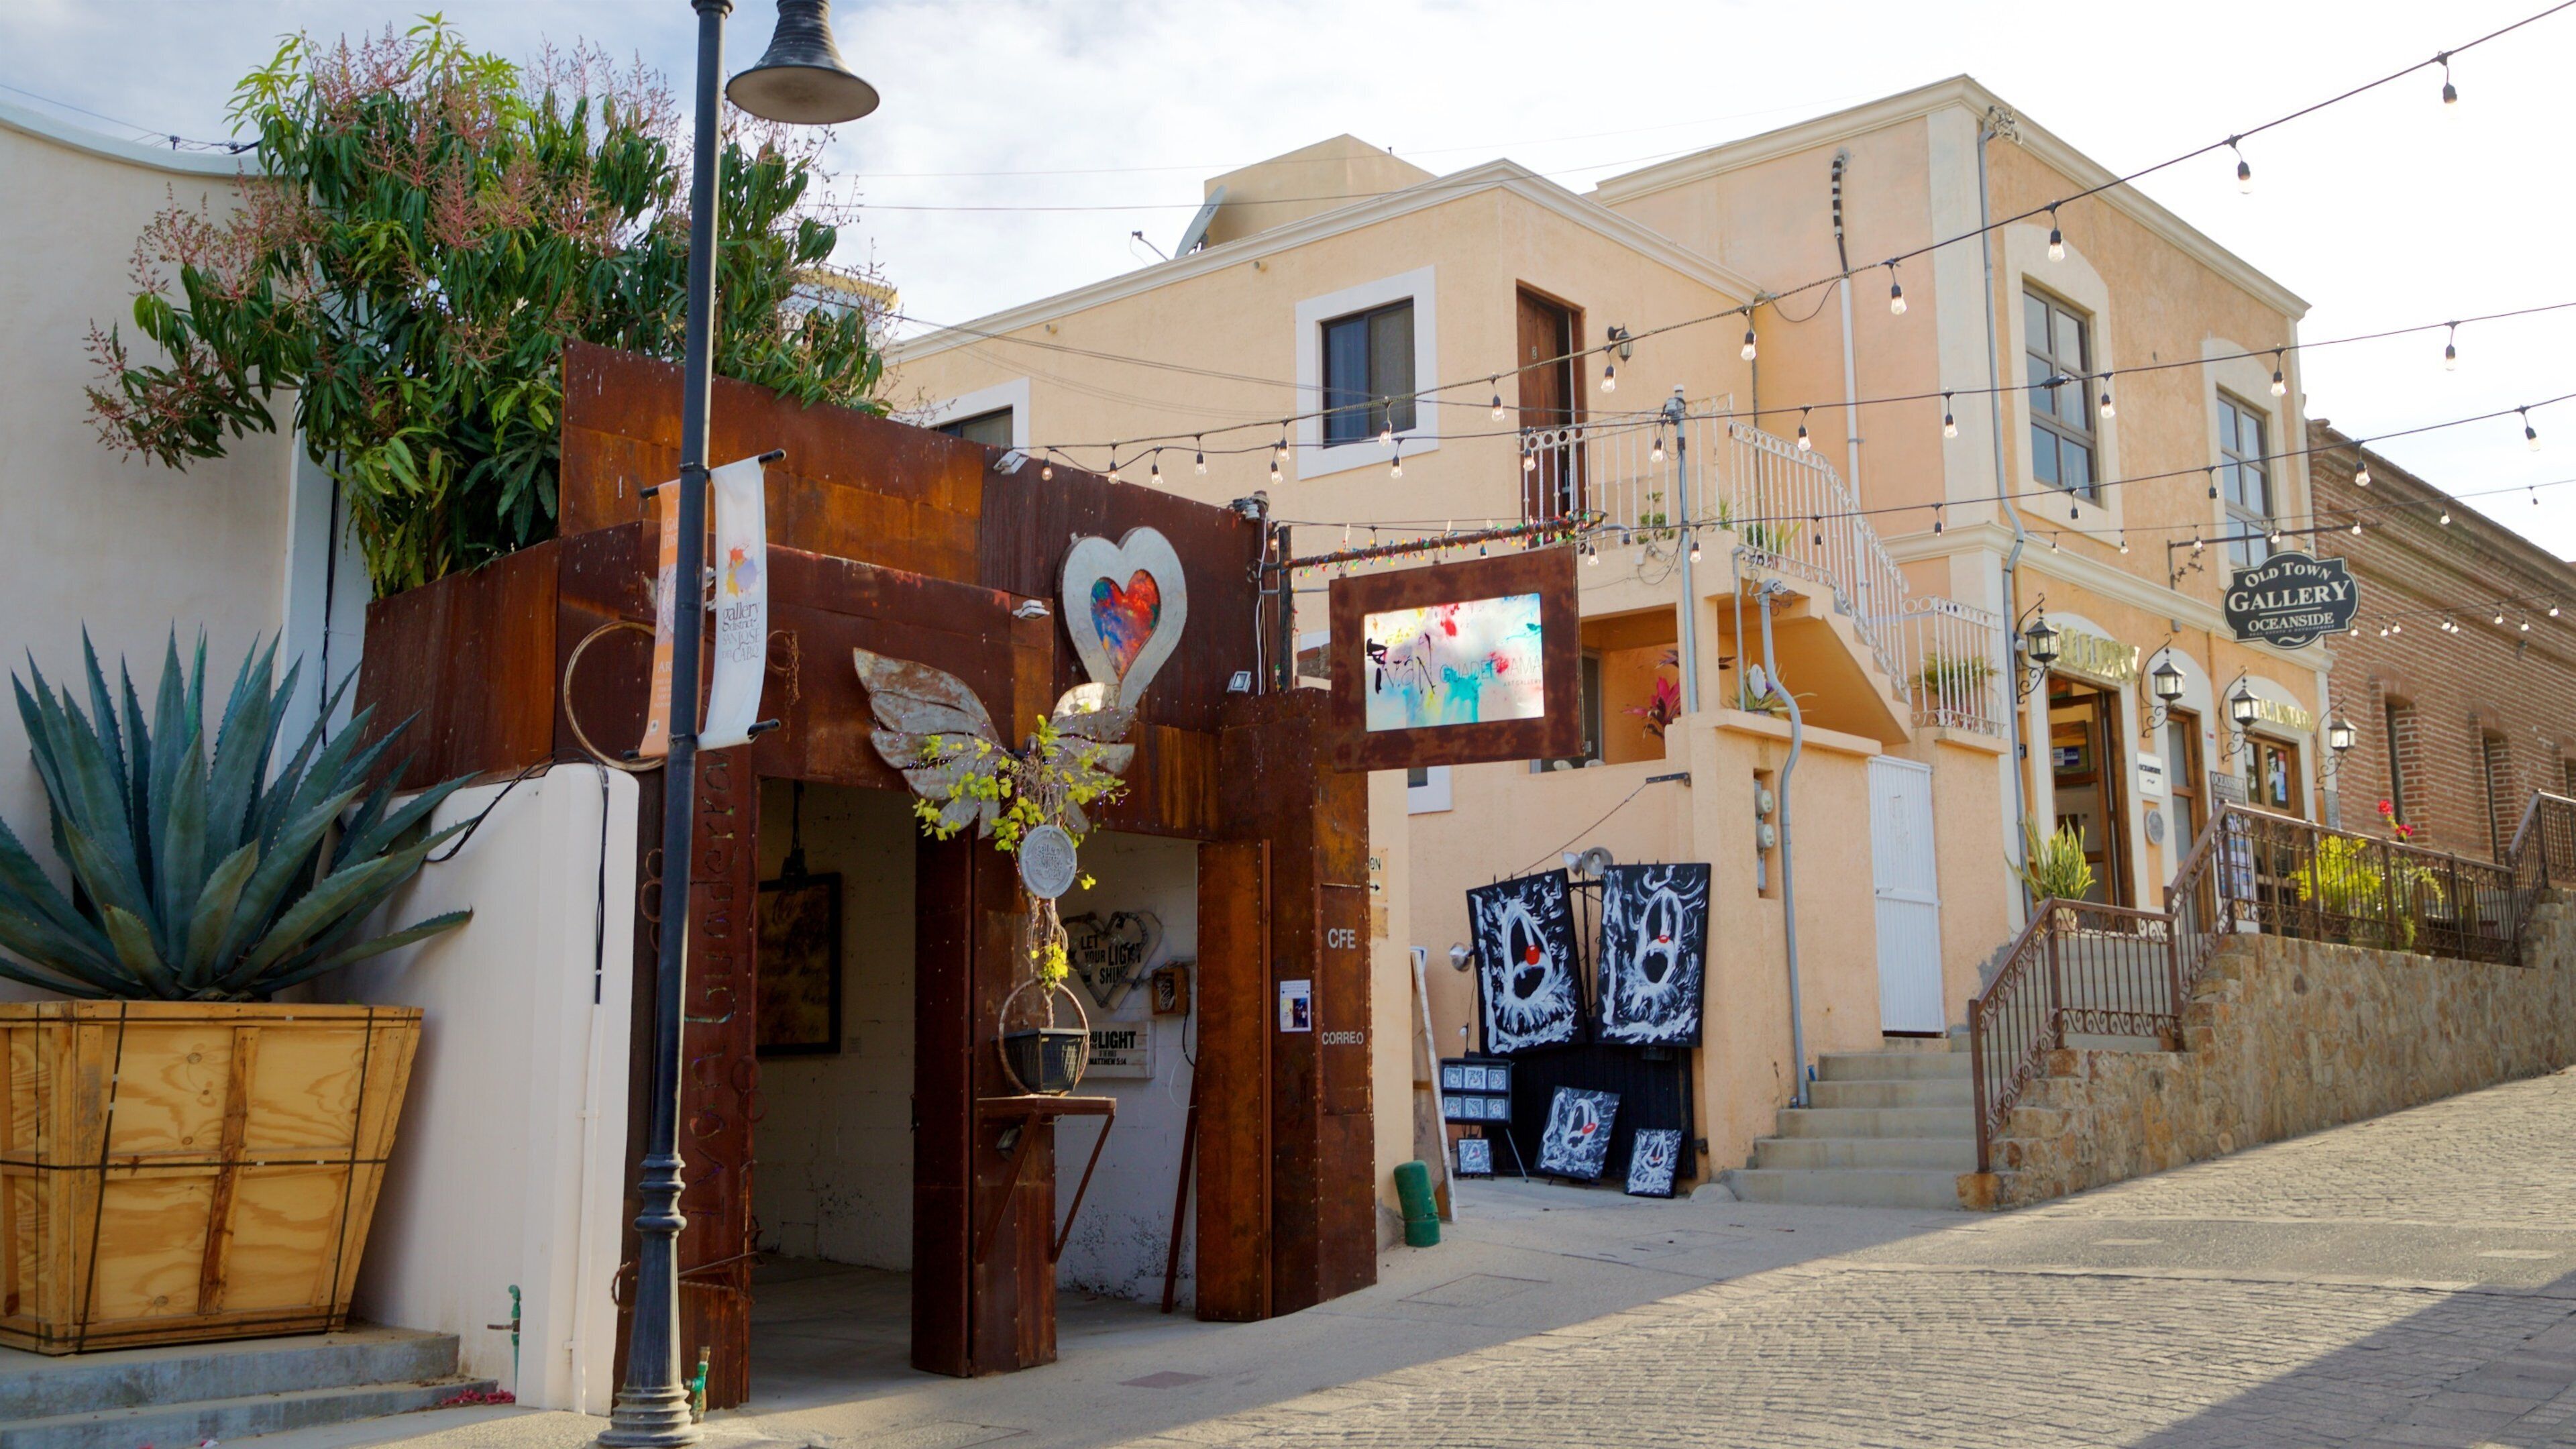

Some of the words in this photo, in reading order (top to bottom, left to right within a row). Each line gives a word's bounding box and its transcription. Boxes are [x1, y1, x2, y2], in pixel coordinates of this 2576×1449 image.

[2245, 568, 2278, 587] OLD
[2281, 561, 2332, 581] TOWN
[2228, 579, 2351, 612] GALLERY
[722, 601, 761, 632] gallery
[2248, 612, 2334, 631] OCEANSIDE
[722, 633, 739, 645] SAN
[685, 749, 739, 1024] Guaderra
[1081, 934, 1097, 950] LET
[1328, 928, 1356, 949] CFE
[1085, 950, 1106, 963] YOUR
[1098, 1030, 1136, 1049] LIGHT
[1322, 1031, 1364, 1045] CORREO
[1089, 1057, 1116, 1065] MATTHEW
